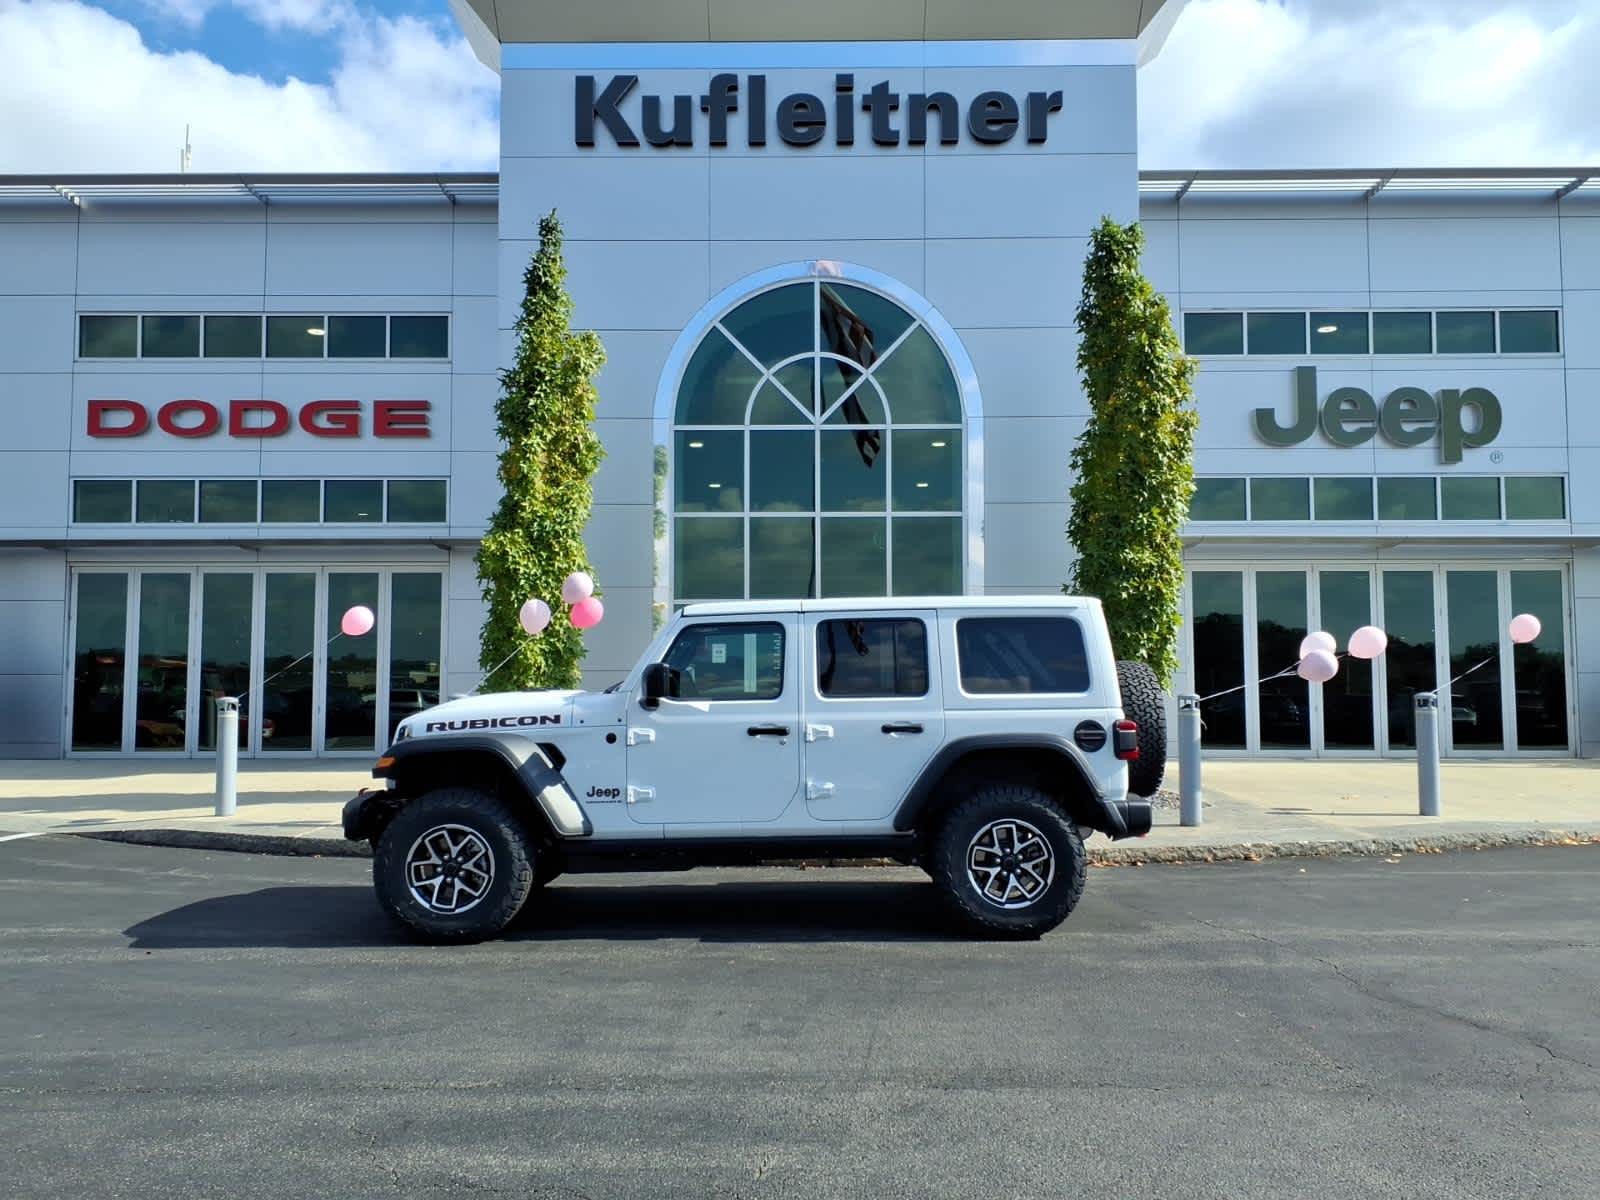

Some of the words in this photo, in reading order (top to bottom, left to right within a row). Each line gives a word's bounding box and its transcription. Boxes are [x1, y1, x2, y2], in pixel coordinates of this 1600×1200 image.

[575, 73, 1063, 147] Kufleitner
[87, 399, 431, 437] DODGE
[1254, 366, 1502, 465] Jeep
[426, 714, 561, 733] RUBICON
[586, 785, 621, 799] Jeep
